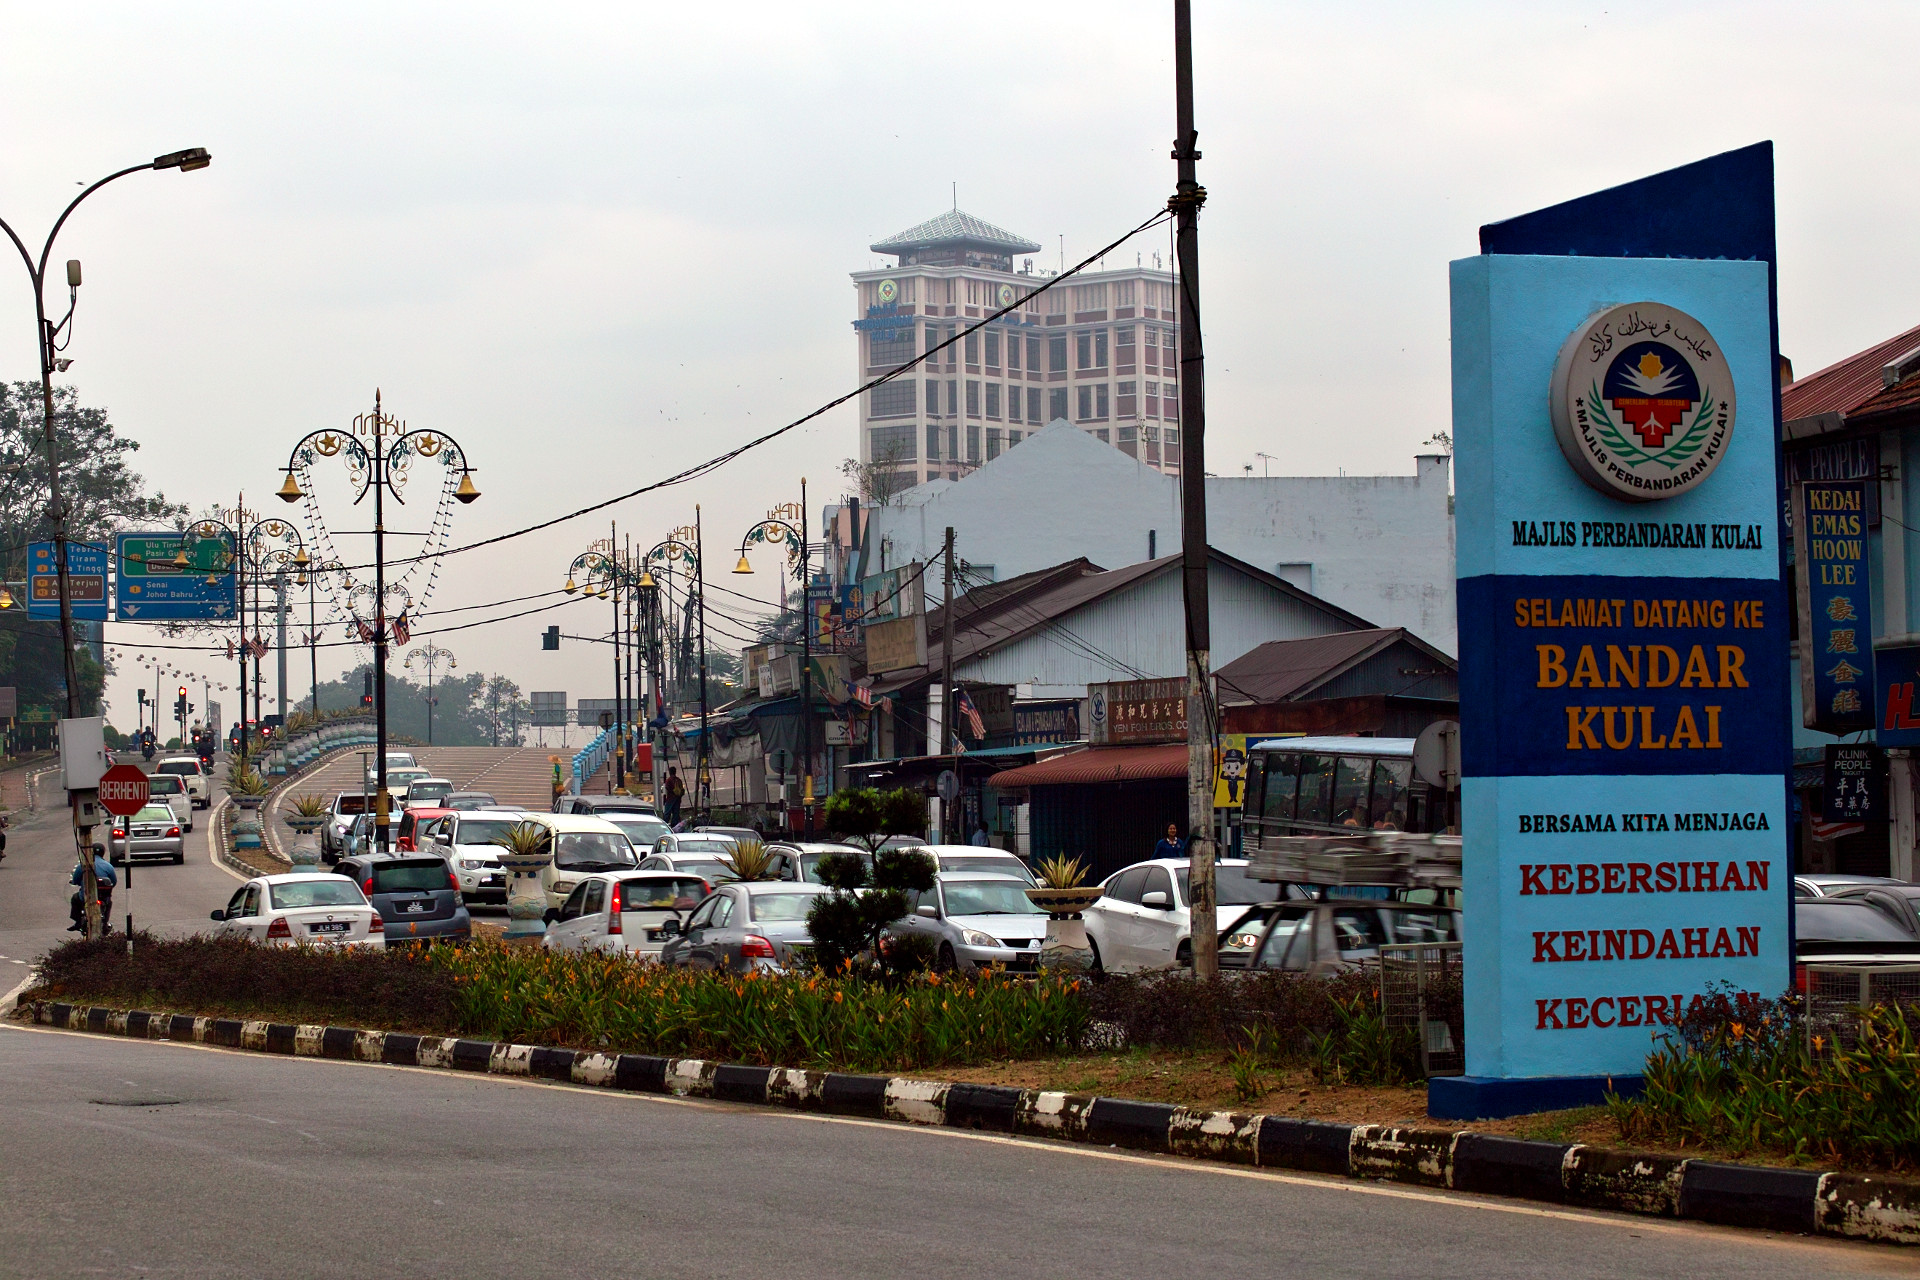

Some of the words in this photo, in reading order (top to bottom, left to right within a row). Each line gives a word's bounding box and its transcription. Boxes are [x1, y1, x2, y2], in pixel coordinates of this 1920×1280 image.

[1576, 409, 1608, 465] MAJLIS
[1607, 460, 1708, 491] PERBANDARAN
[1707, 413, 1728, 460] KULAI
[1809, 489, 1861, 511] KEDAI
[1512, 520, 1577, 547] MAJLIS
[1581, 521, 1706, 549] PERBANDARAN
[1711, 523, 1762, 550] KULAI
[1812, 515, 1861, 536] EMAS
[1812, 539, 1862, 560] HOOW
[77, 565, 104, 573] Tinggi
[1821, 564, 1857, 585] LEE
[70, 580, 99, 588] Terjun
[170, 590, 193, 598] Bahru
[1515, 598, 1625, 628] SELAMAT
[1633, 599, 1726, 629] DATANG
[1733, 600, 1764, 629] KE
[1535, 644, 1749, 689] BANDAR
[1565, 705, 1723, 749] KULAI
[1834, 760, 1872, 770] PEOPLE
[1837, 749, 1869, 760] KLINIK
[101, 781, 148, 800] BERHENTI
[1836, 777, 1869, 796] 平民
[1519, 814, 1617, 833] BERSAMA
[1622, 813, 1669, 832] KITA
[1674, 812, 1769, 832] MENJAGA
[1519, 860, 1770, 895] KEBERSIHAN
[1532, 926, 1761, 963] KEINDAHAN
